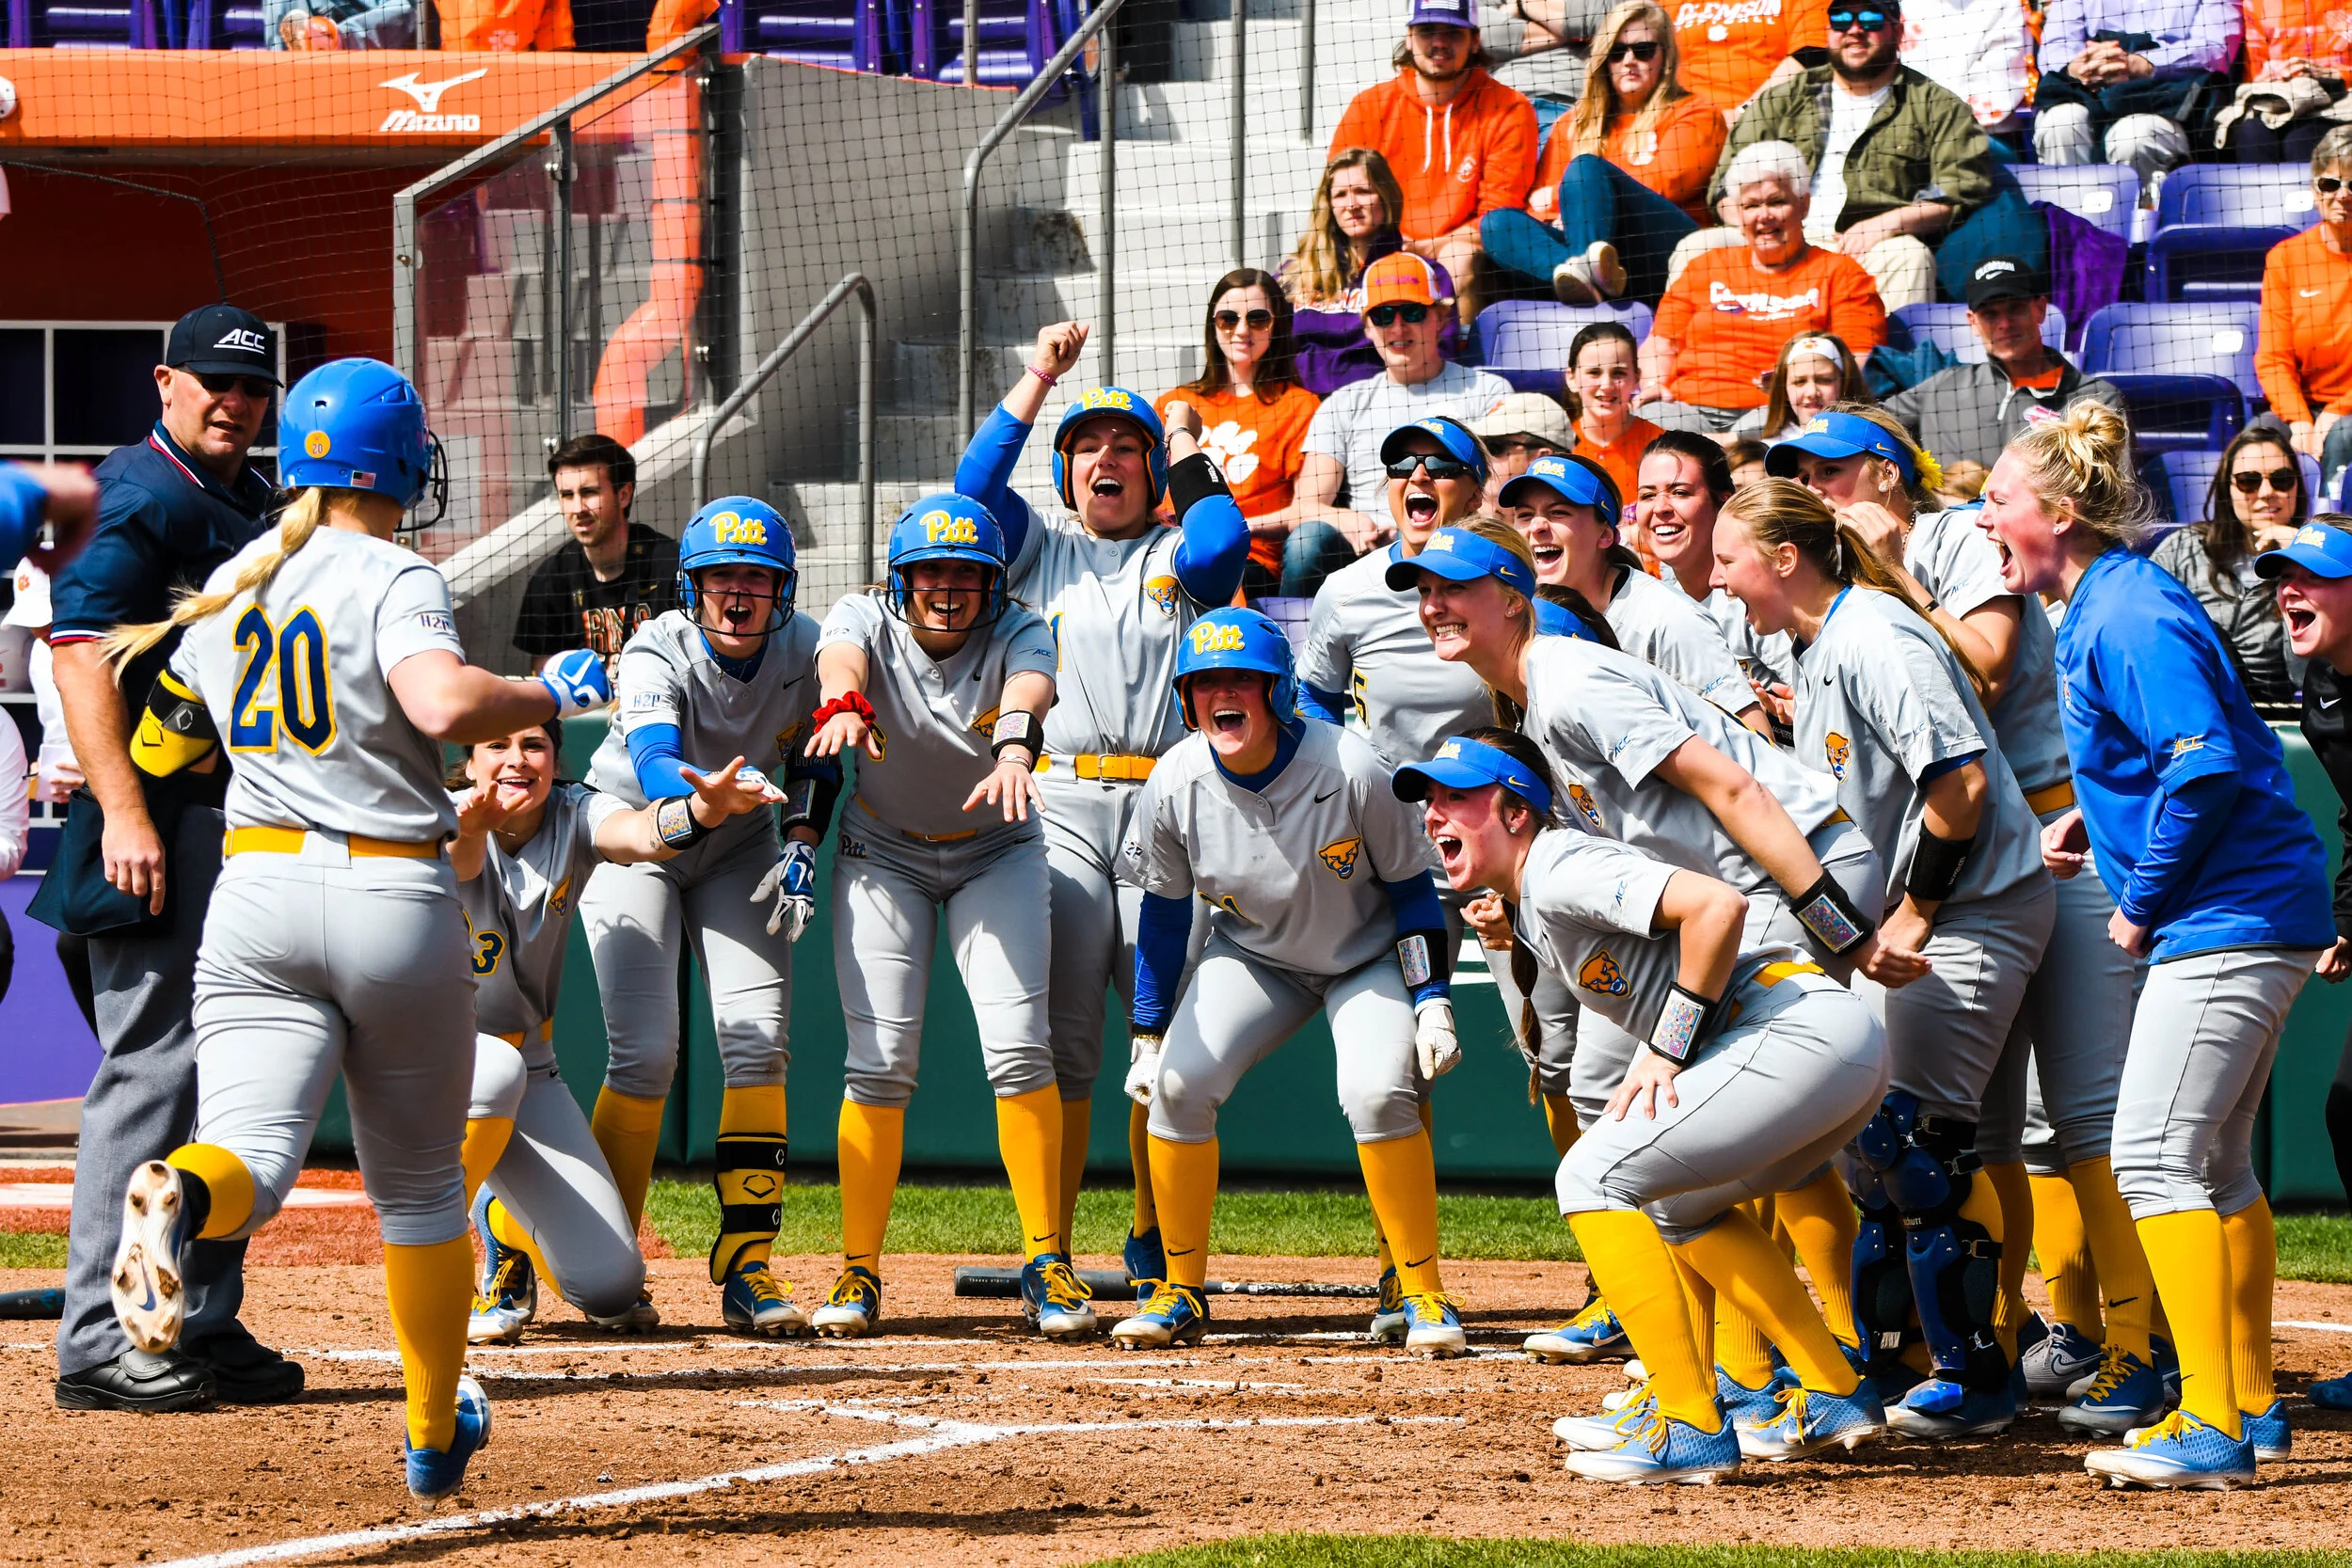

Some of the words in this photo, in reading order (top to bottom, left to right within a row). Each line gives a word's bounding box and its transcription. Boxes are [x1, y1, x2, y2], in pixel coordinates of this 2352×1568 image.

[216, 328, 265, 352] ACC
[1077, 386, 1134, 411] Pitt
[312, 443, 324, 454] 20
[709, 512, 768, 546] Pitt
[919, 510, 979, 545] Pitt
[1189, 622, 1246, 655] Pitt
[228, 602, 338, 757] 20
[1705, 676, 1724, 696] ACC
[1613, 734, 1631, 758] ACC
[2172, 735, 2204, 758] ACC
[842, 835, 867, 859] Pitt
[468, 917, 506, 976] 3
